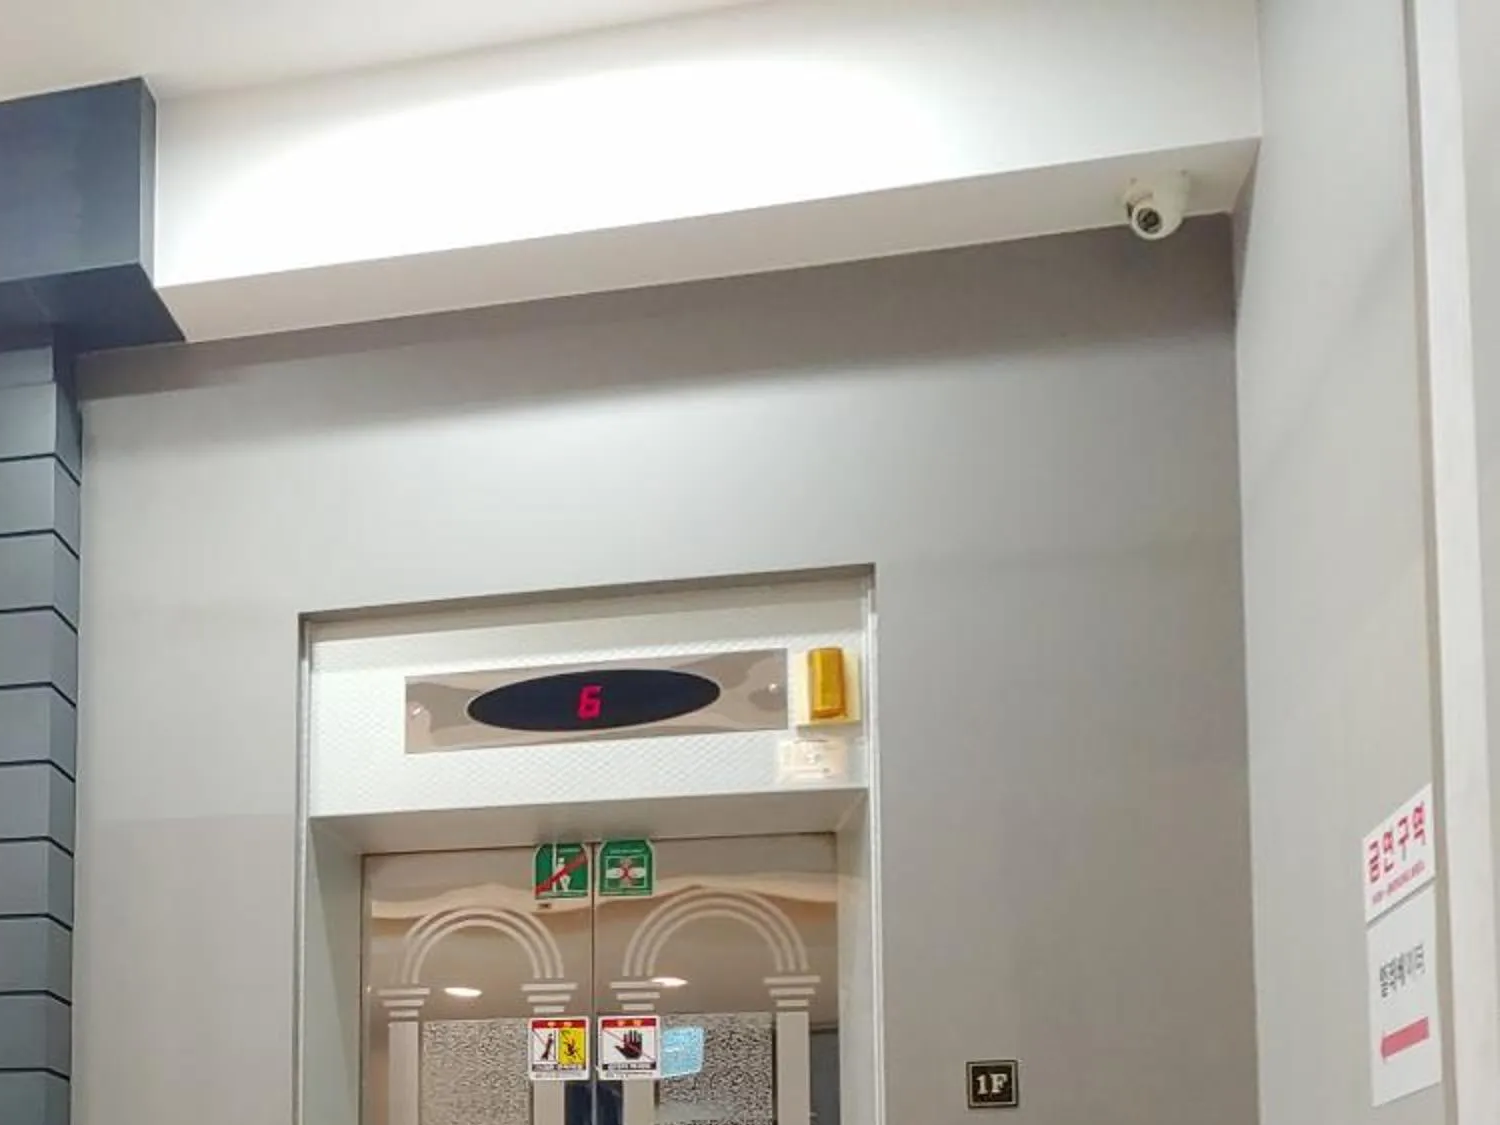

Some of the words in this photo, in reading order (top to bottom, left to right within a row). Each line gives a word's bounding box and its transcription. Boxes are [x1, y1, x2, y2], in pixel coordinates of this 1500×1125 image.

[577, 684, 603, 720] 6
[1369, 801, 1426, 883] 금연구역
[975, 1072, 1009, 1096] 1F
